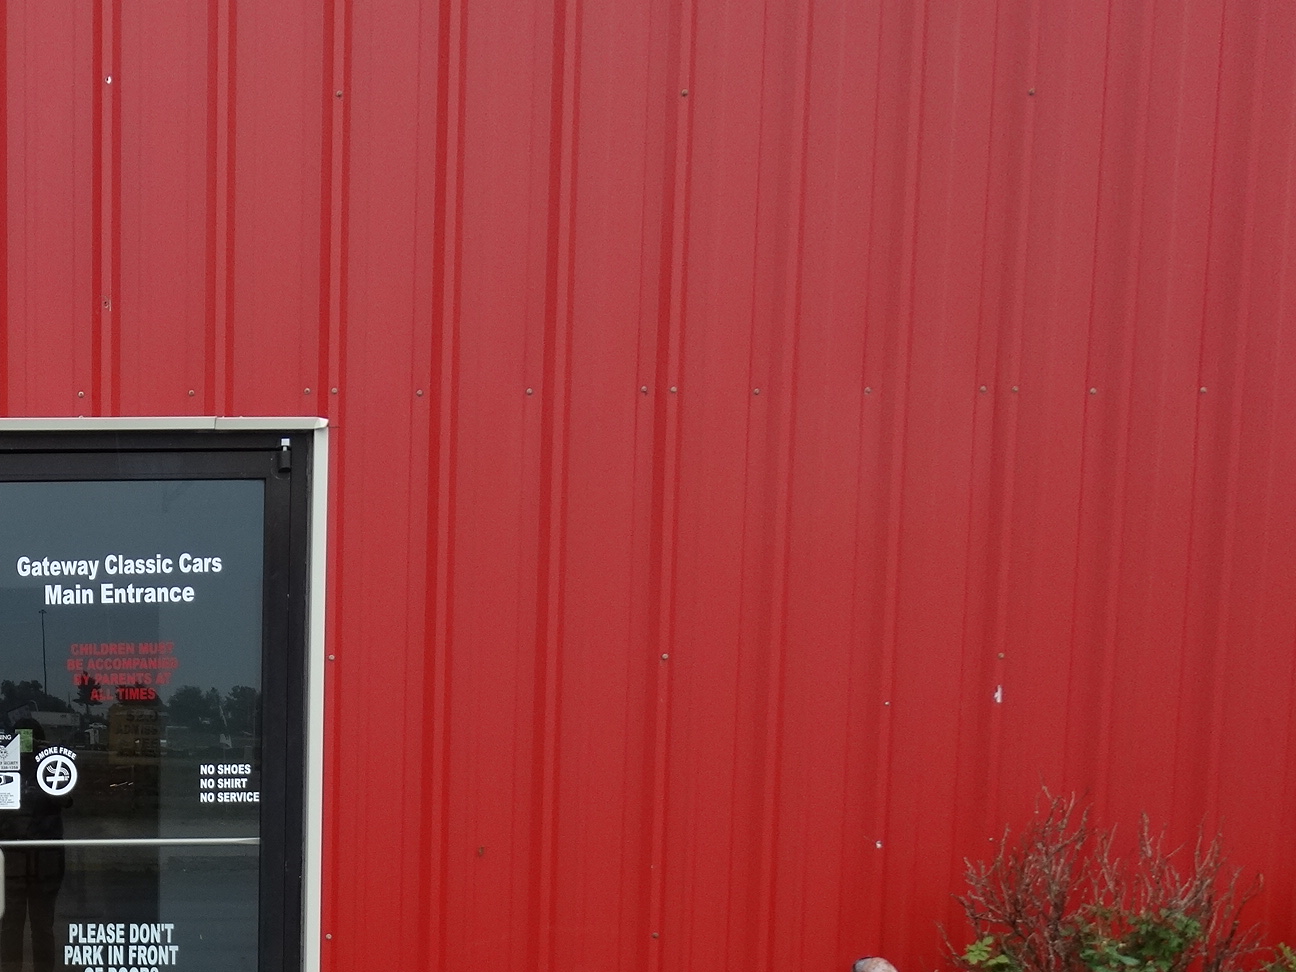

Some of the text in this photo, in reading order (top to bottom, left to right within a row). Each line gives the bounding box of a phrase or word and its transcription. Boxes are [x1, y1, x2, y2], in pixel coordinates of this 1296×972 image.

[17, 553, 222, 580] Gateway Classic Cars
[44, 583, 195, 605] Main Entrance
[70, 641, 175, 655] CHILDREN MUST
[67, 658, 84, 670] BE
[73, 673, 89, 686] BY
[95, 672, 153, 685] PARENTS
[90, 688, 156, 701] ALL TIMES
[34, 746, 77, 763] SMOKE FREE
[200, 764, 251, 775] NO SHOES
[200, 778, 248, 789] NO SHIRT
[200, 791, 260, 803] NO SERVICE
[68, 923, 174, 944] PLEASE DON'T
[64, 945, 179, 966] PARK IN FRONT
